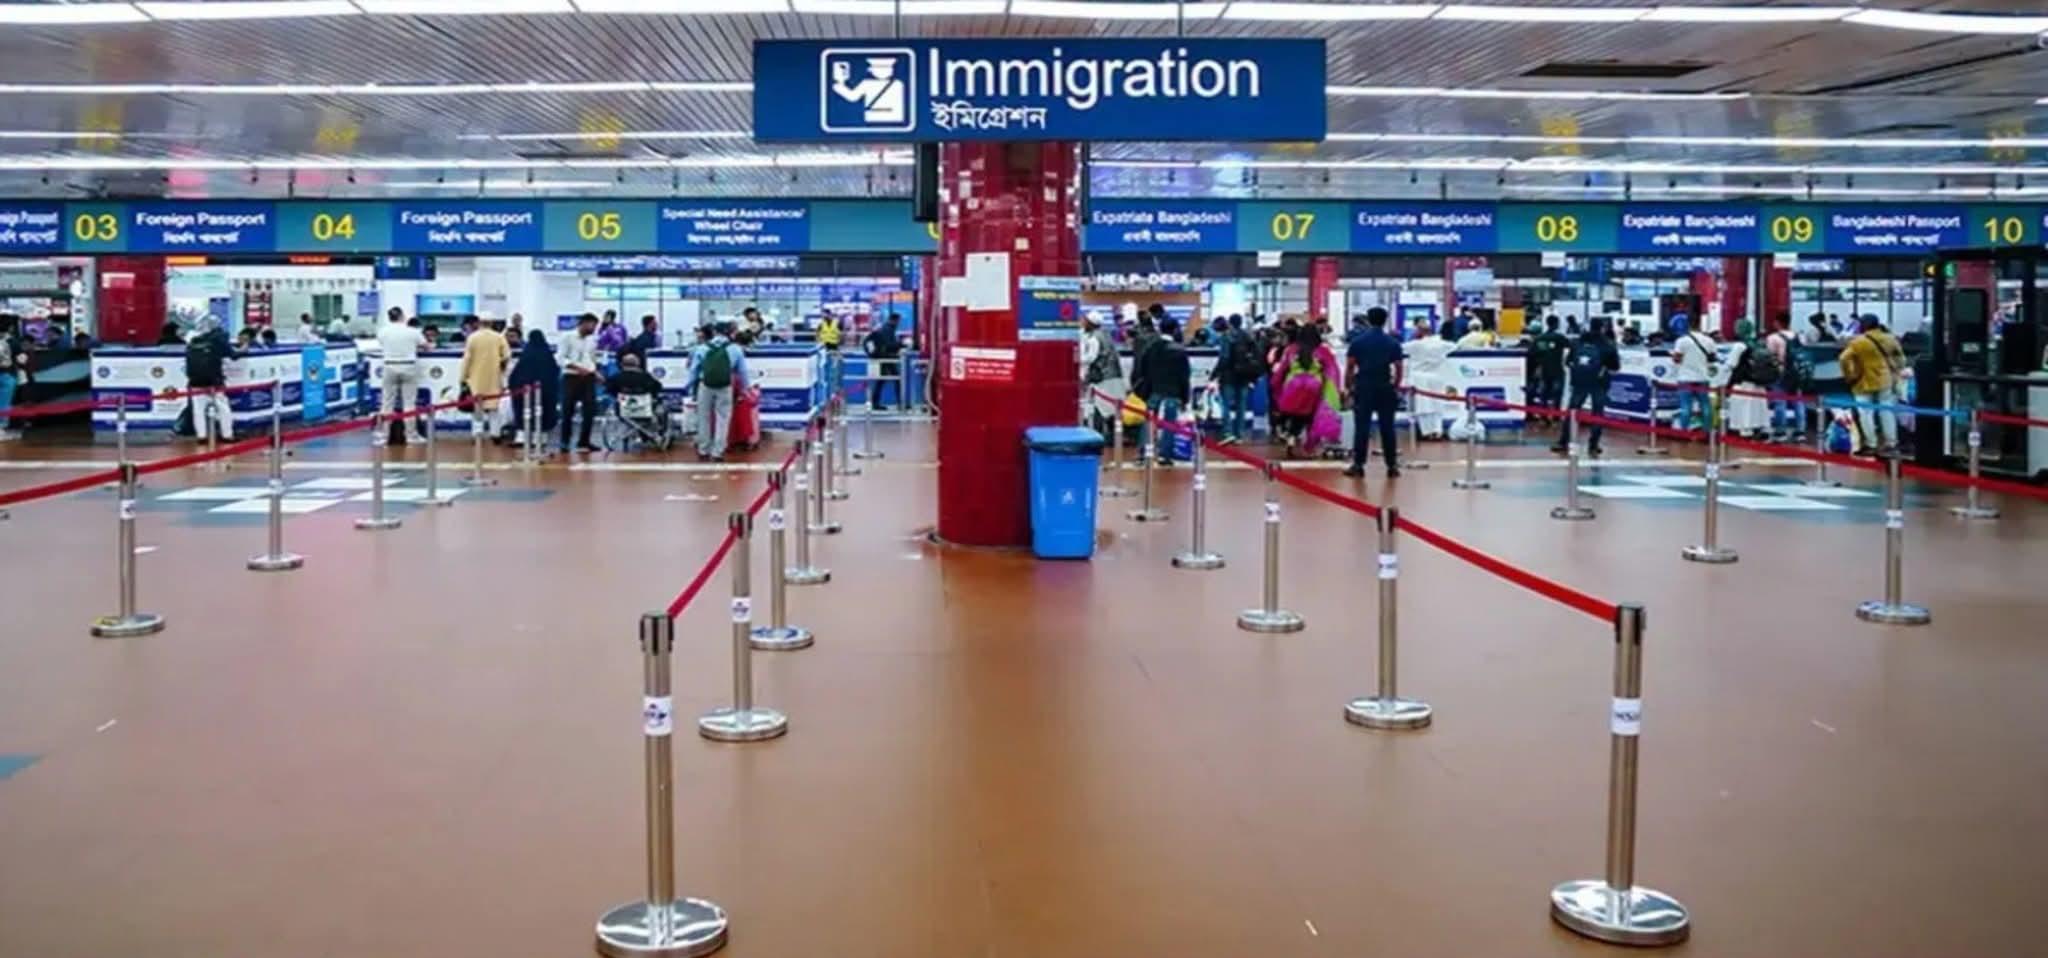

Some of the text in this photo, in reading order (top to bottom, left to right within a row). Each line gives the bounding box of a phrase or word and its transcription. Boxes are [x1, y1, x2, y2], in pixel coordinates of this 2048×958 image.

[930, 48, 1258, 112] Immigration
[931, 101, 1046, 130] ইমিগ্রেশন
[75, 214, 118, 240] 03
[136, 212, 265, 228] Foreign Passport
[313, 214, 355, 240] 04
[402, 211, 532, 227] Foreign Passport
[578, 213, 621, 240] 05
[1272, 213, 1314, 240] 07
[1537, 216, 1578, 241] 08
[1772, 216, 1813, 242] 09
[1986, 217, 2023, 244] 10
